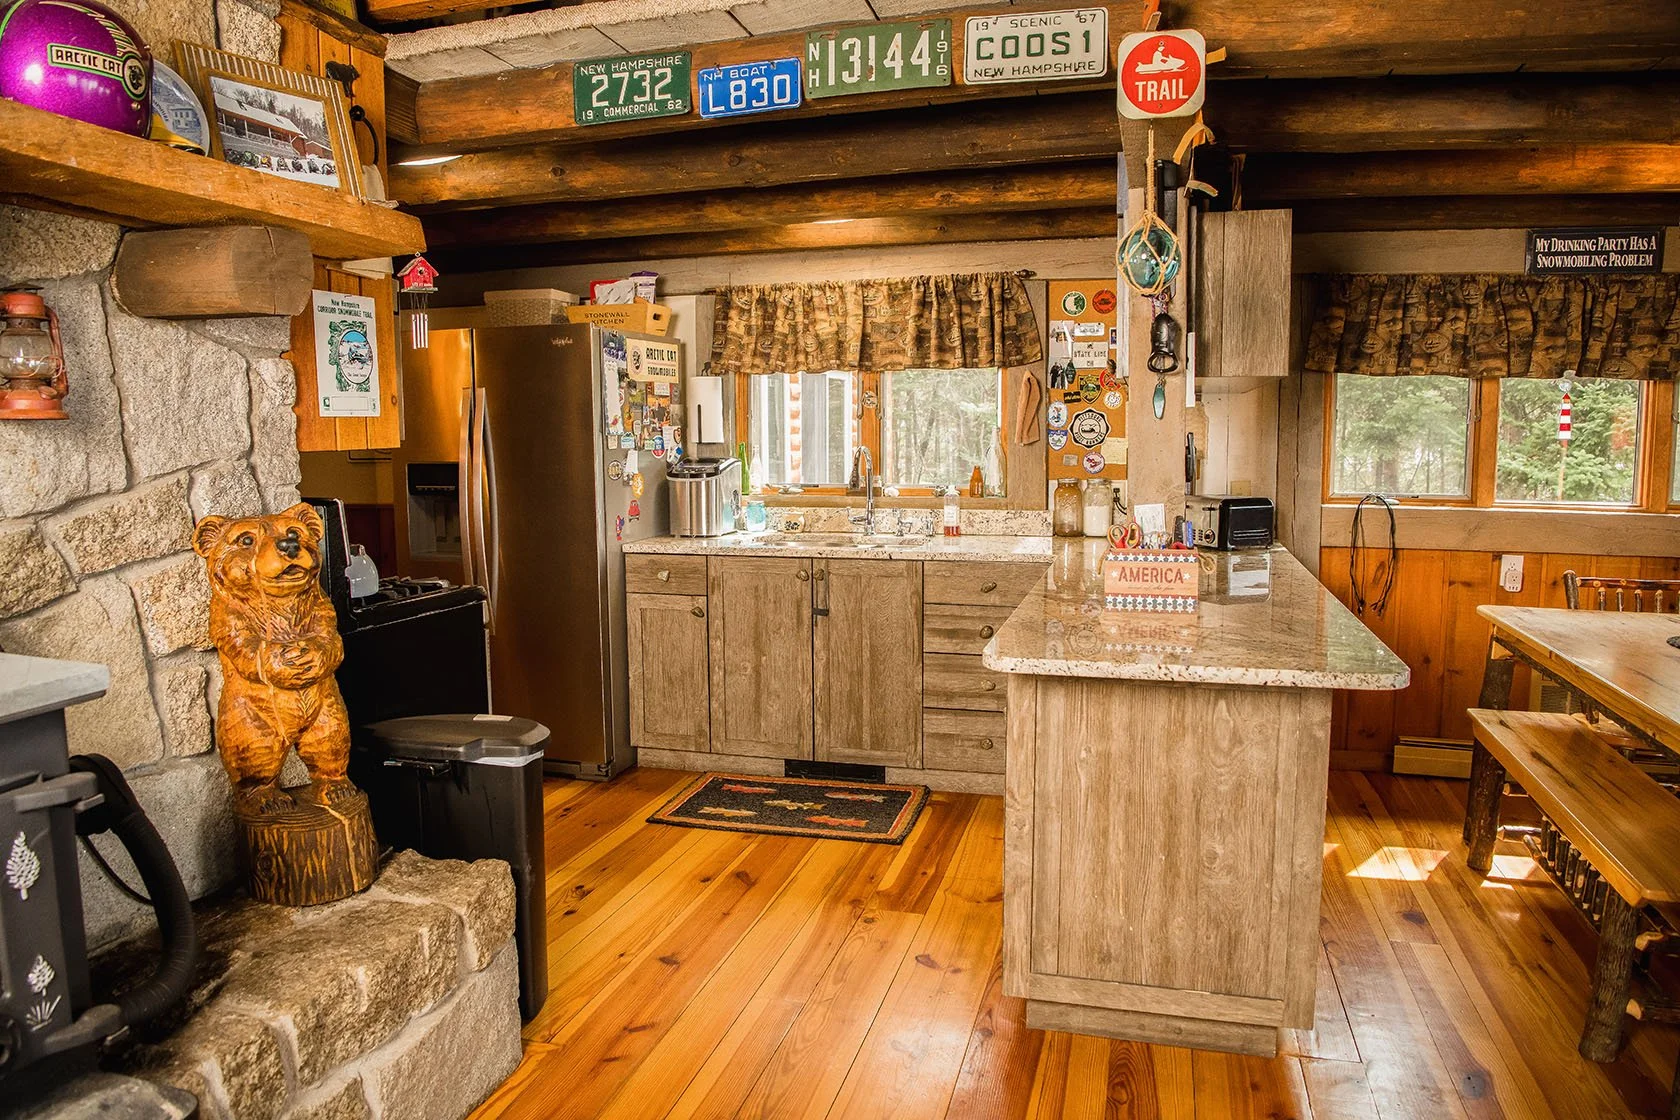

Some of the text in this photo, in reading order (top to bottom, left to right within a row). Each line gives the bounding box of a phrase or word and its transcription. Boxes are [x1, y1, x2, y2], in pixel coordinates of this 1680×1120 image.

[975, 13, 1097, 31] 19 SCENIC 67
[976, 30, 1091, 61] COOS 1
[55, 49, 121, 74] ARCTIC CAT
[580, 55, 683, 76] NEW HAMPSHIRE
[827, 30, 931, 86] 13144
[703, 65, 768, 82] NH BOAT
[974, 61, 1097, 78] NEW HAMPSHIRE
[591, 67, 672, 108] 2732
[708, 74, 791, 113] L830
[1134, 79, 1189, 103] TRAIL
[582, 99, 682, 121] 19 COMMERCIAL 62
[1551, 237, 1596, 252] DRINKING
[1597, 236, 1629, 251] PARTY
[1630, 236, 1648, 250] HAS
[1649, 235, 1657, 250] A
[1536, 252, 1653, 268] SNOWMOBILING PROBLEM
[584, 311, 630, 319] STONEWALL
[591, 318, 625, 326] KITCHEN
[645, 347, 677, 362] ARCTIC CAT
[1074, 350, 1091, 358] STATE
[1118, 566, 1184, 584] AMERICA
